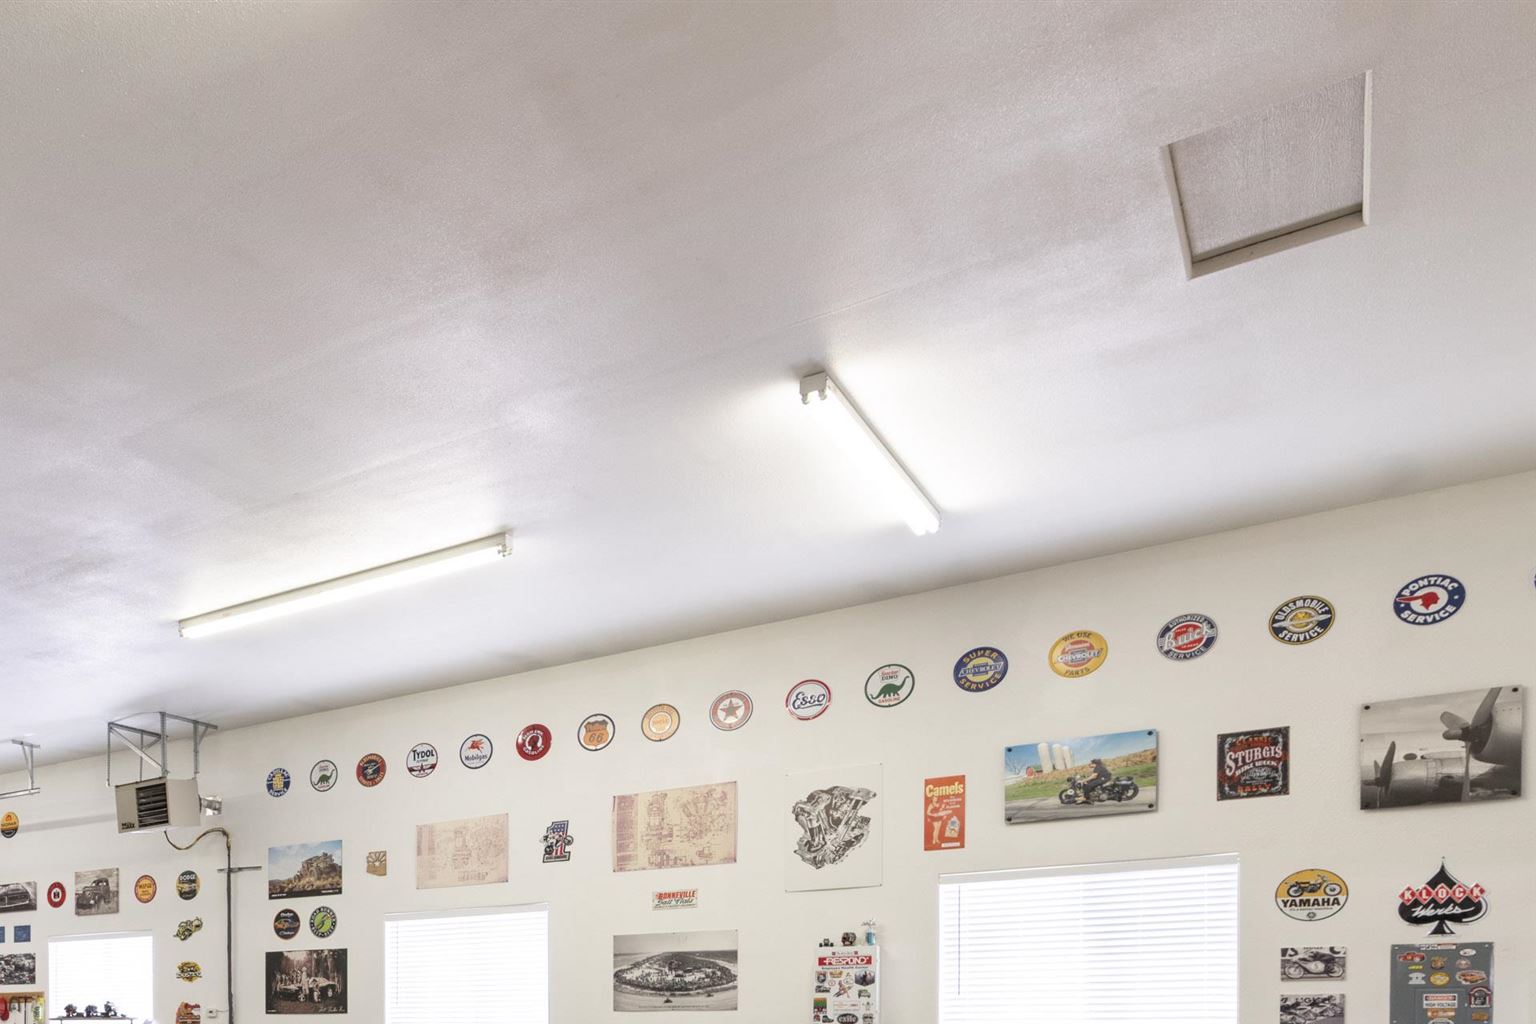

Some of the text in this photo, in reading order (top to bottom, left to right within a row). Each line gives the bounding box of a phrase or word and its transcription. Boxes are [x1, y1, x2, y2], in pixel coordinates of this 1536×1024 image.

[1402, 576, 1459, 596] PONTIAC
[1275, 597, 1328, 621] OLDSMOBILE
[1400, 603, 1457, 624] SERVICE
[1062, 631, 1093, 642] WE USE
[1164, 619, 1216, 651] Buick
[1278, 625, 1325, 643] SERVICE
[962, 649, 998, 663] SUPER
[1057, 649, 1103, 663] CHEVROLET
[962, 663, 1002, 675] CHEVROLET
[1064, 667, 1091, 677] PARTS
[959, 671, 1002, 690] SERVICE
[792, 690, 826, 710] Esso
[589, 732, 604, 743] 66
[412, 749, 435, 761] TYDOL
[1225, 745, 1283, 776] STURGIS
[925, 781, 964, 798] Camels
[655, 890, 696, 900] BONNEVILLE
[1404, 886, 1481, 900] KLOCK
[1281, 896, 1341, 908] YAMAHA
[1411, 903, 1475, 918] Werks
[825, 955, 870, 966] RESPOND
